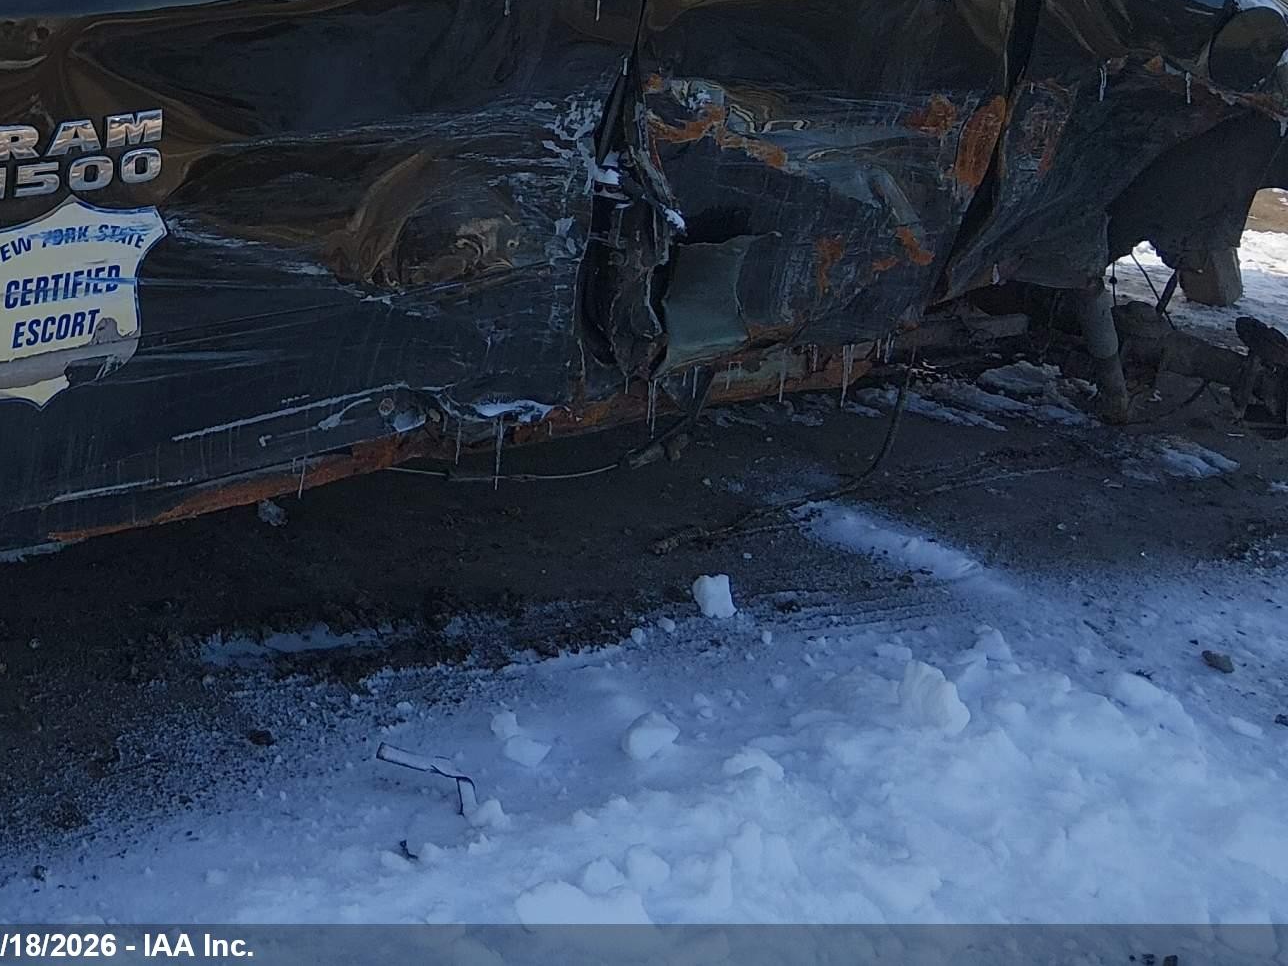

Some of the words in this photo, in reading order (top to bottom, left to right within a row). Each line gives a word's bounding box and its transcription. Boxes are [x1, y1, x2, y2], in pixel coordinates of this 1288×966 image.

[39, 225, 90, 248] YORK
[97, 224, 149, 249] STATE
[4, 264, 121, 309] CERTIFIED
[12, 308, 101, 349] ESCORT
